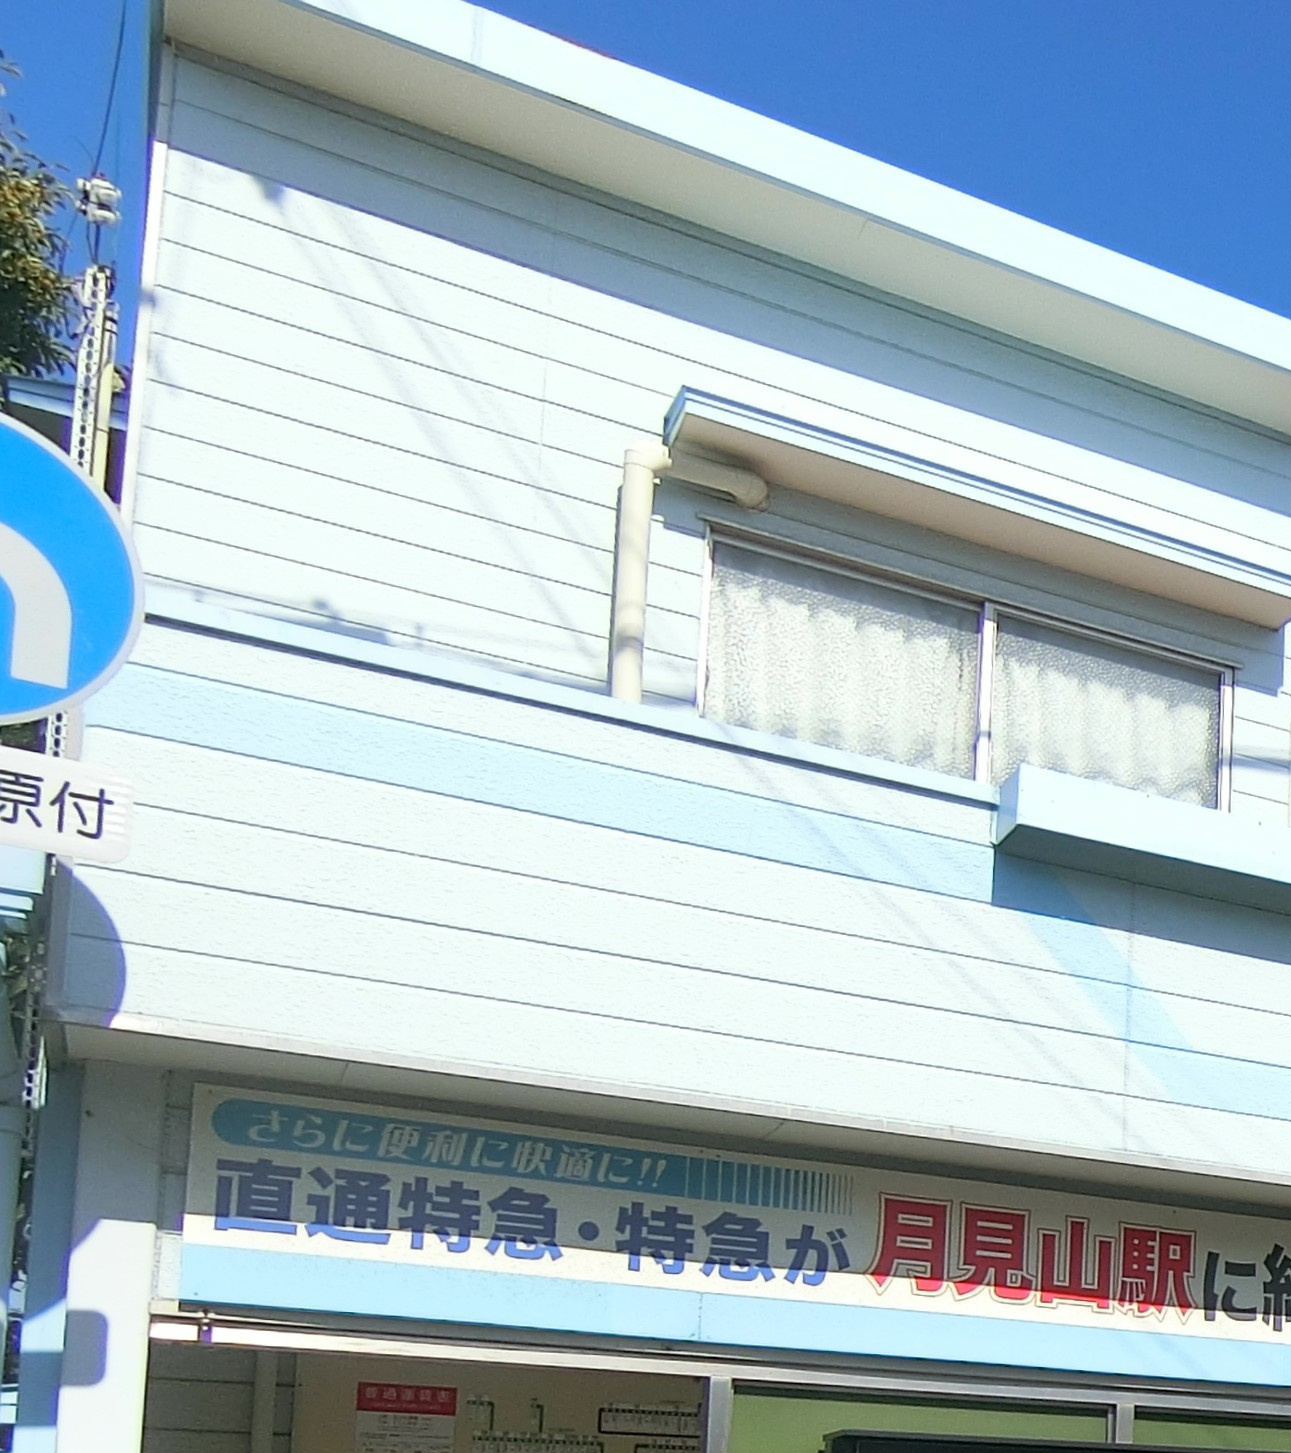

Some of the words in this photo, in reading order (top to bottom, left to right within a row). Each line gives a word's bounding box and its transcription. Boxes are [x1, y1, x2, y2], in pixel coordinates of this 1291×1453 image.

[247, 1108, 669, 1190] さらに便利に快適に!!
